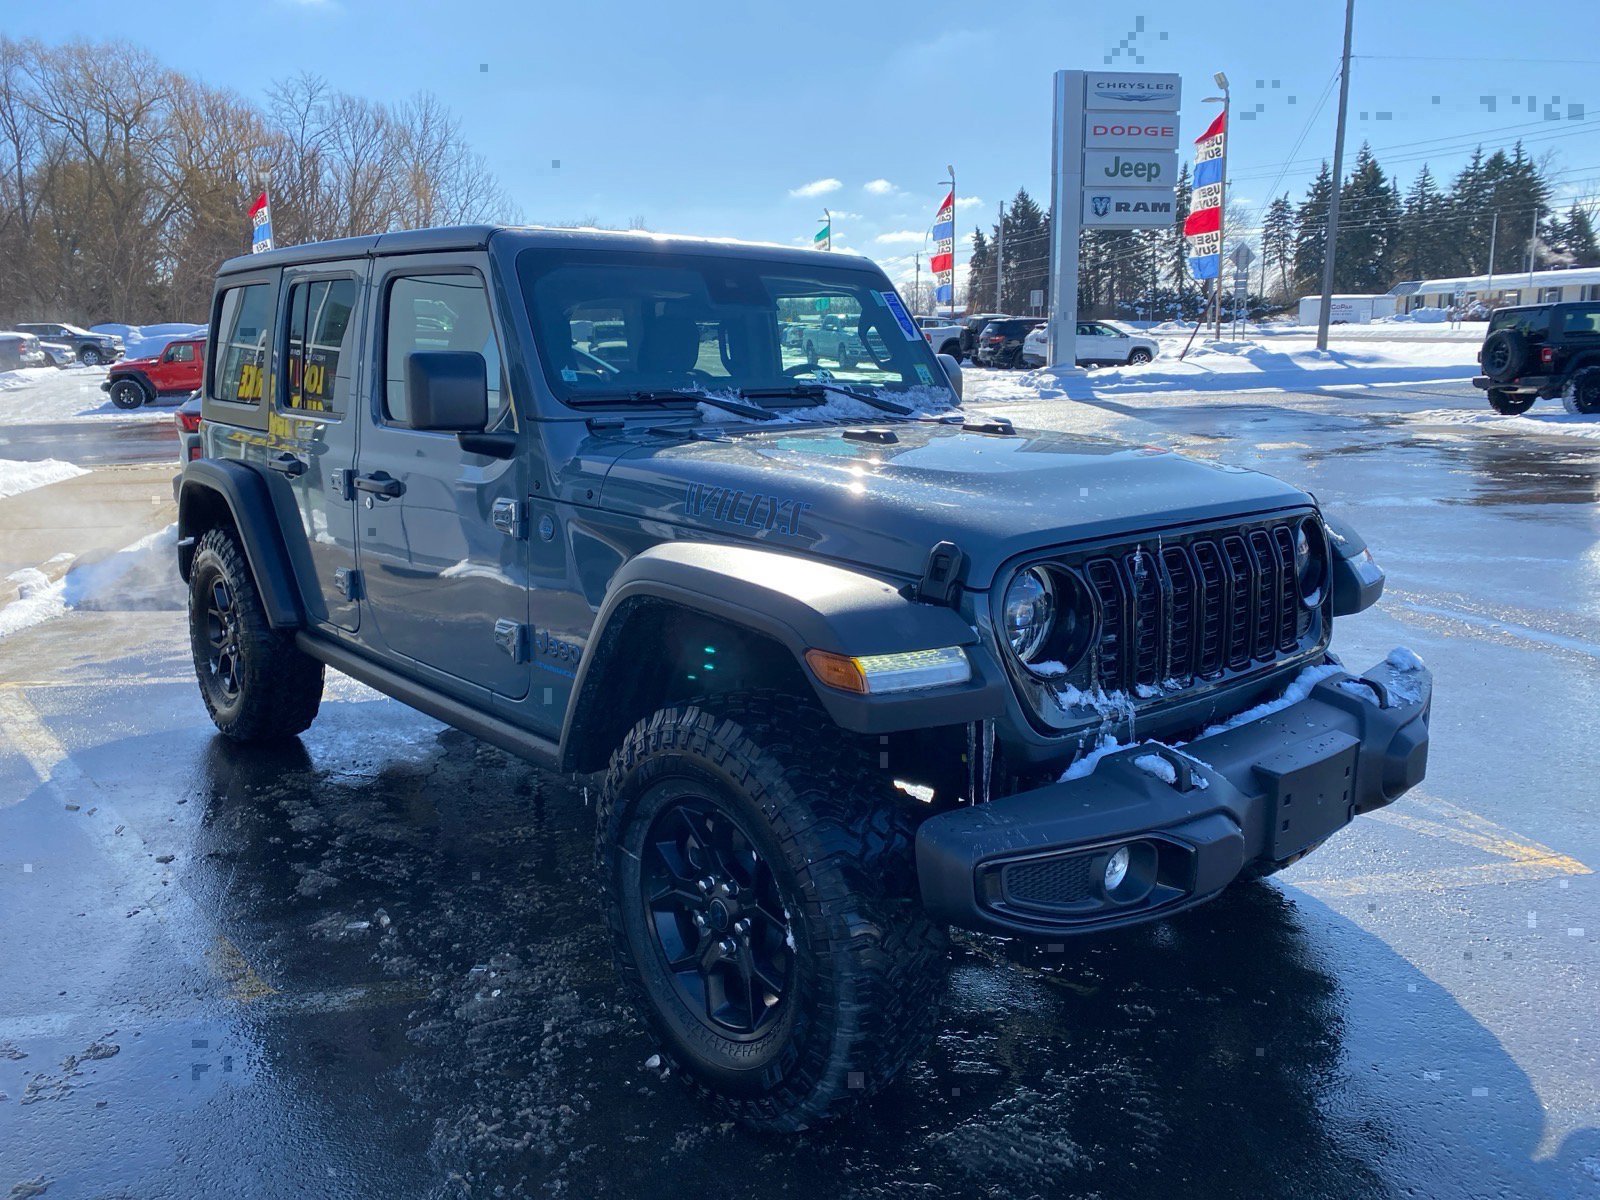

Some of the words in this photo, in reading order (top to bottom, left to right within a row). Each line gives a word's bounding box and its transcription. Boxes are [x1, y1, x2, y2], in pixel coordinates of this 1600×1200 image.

[1096, 82, 1174, 90] CHRYSLER
[1093, 125, 1174, 137] DODGE
[1104, 156, 1161, 182] Jeep
[1115, 201, 1170, 213] RAM
[685, 480, 813, 536] WILLYS
[536, 631, 581, 670] Jeep
